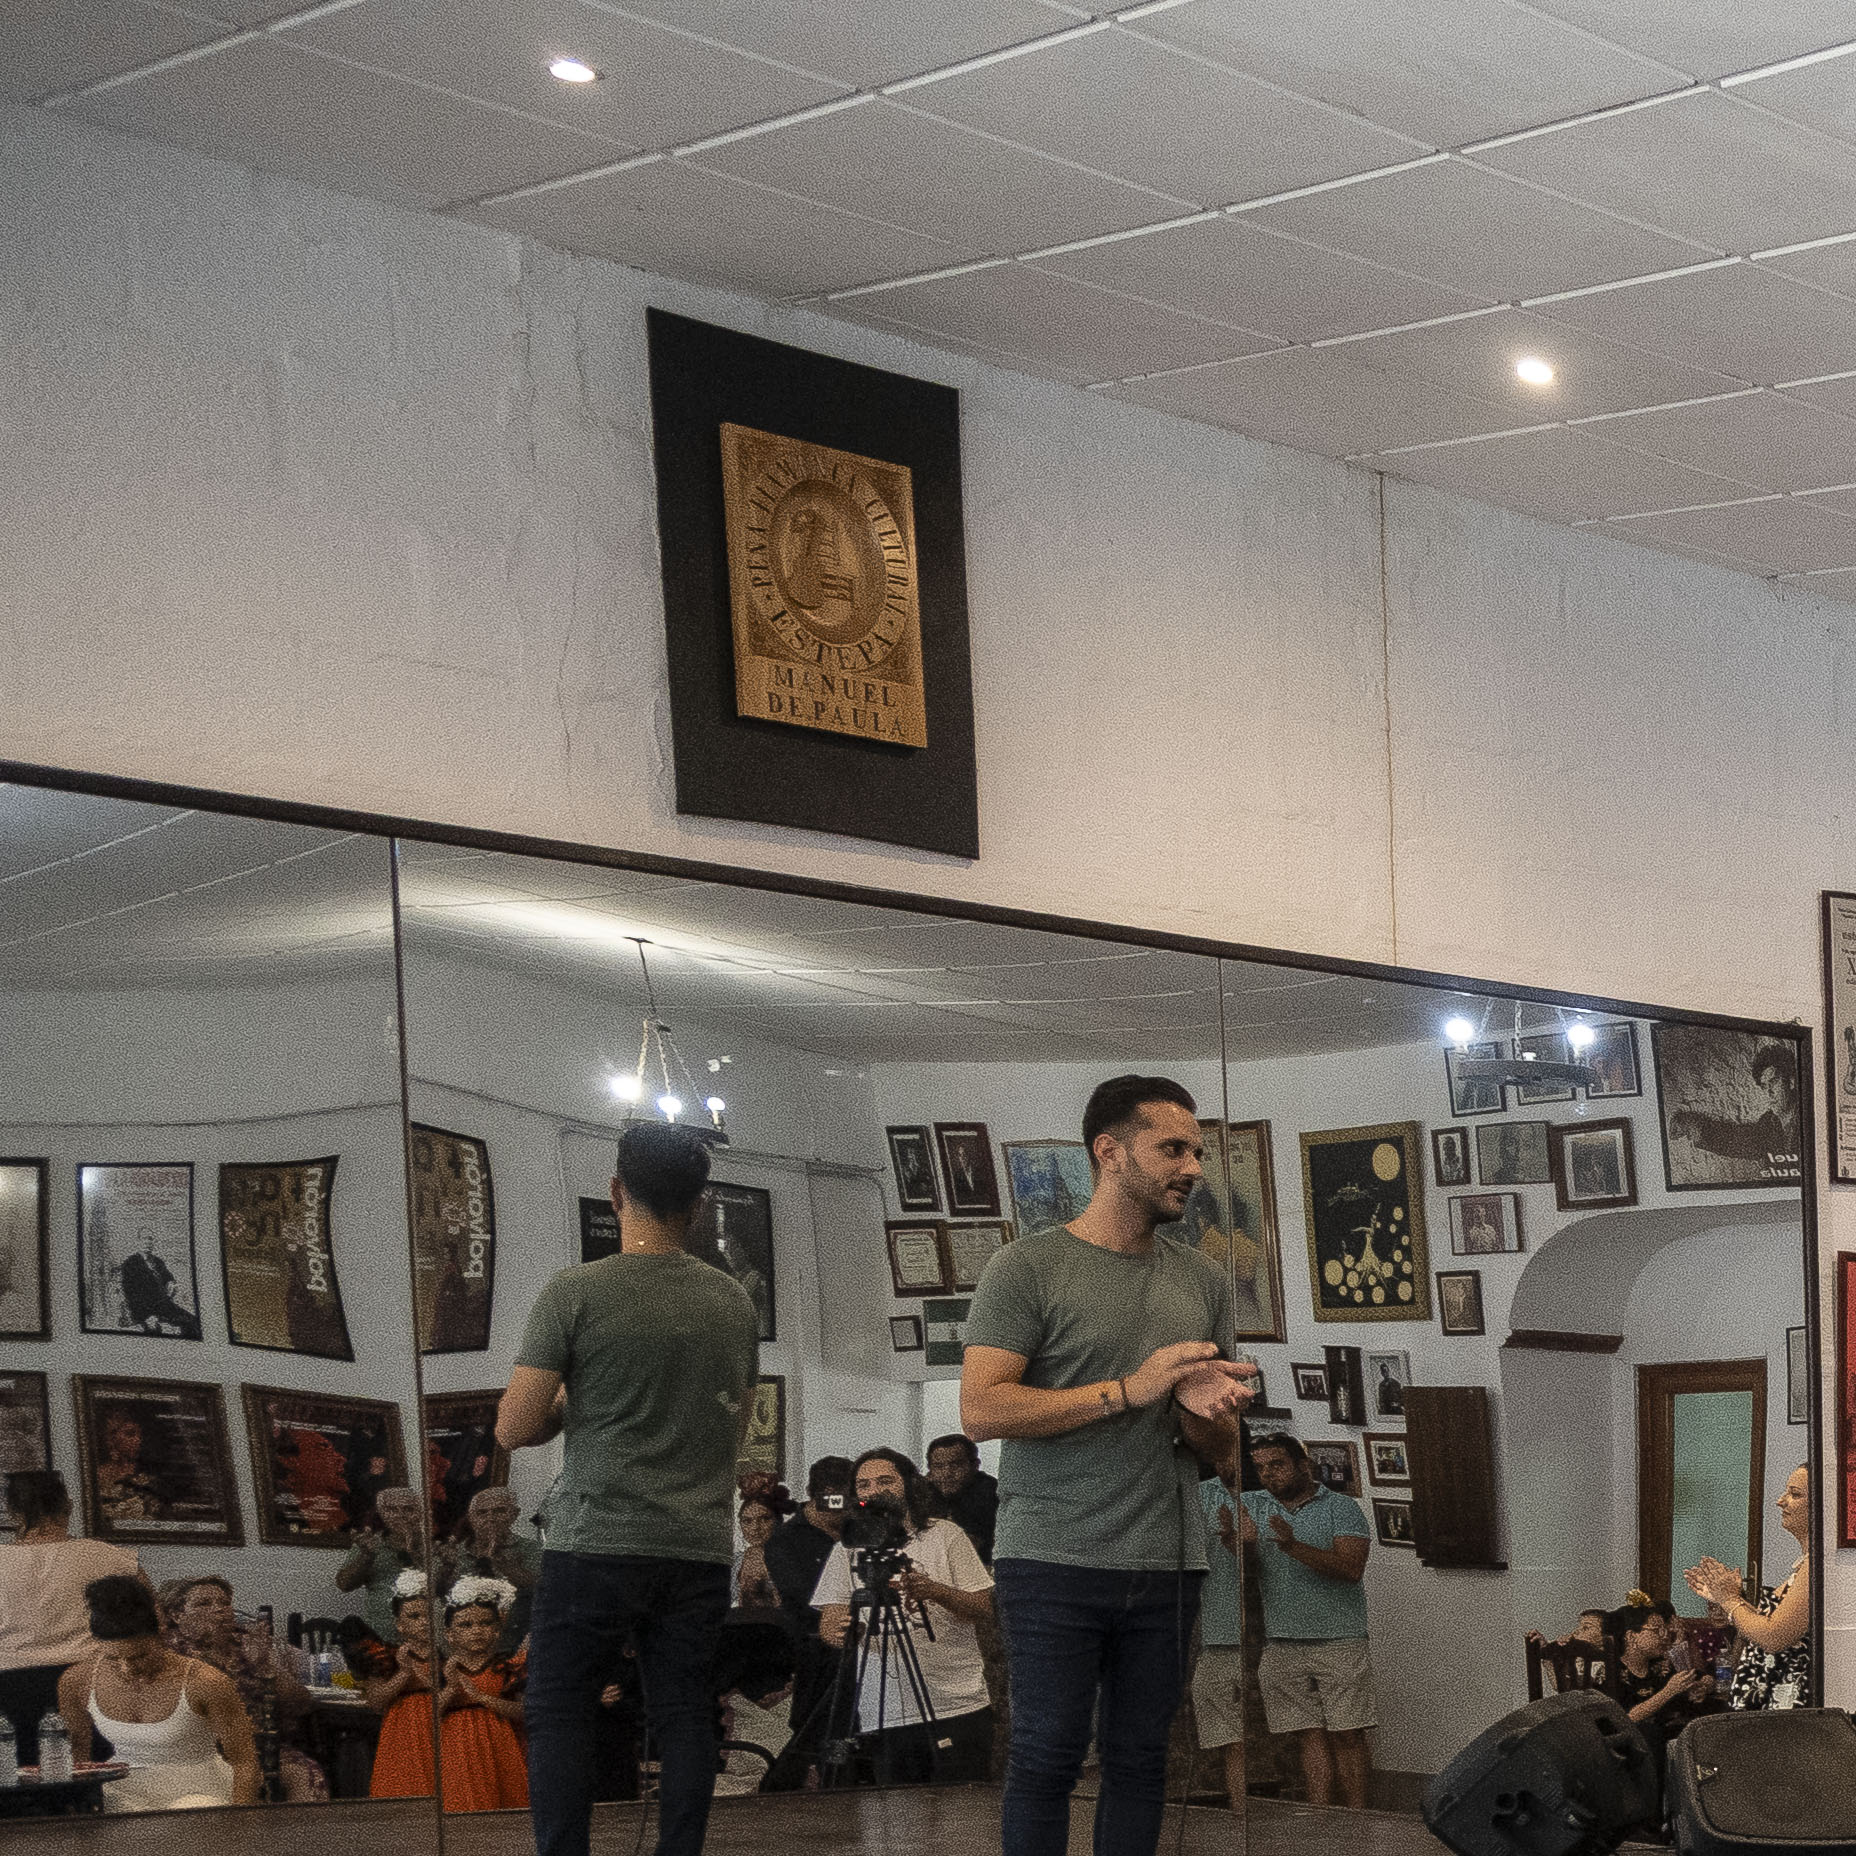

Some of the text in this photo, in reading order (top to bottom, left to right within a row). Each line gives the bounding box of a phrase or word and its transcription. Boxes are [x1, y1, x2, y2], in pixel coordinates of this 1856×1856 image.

[770, 608, 895, 670] ESTEPA
[774, 664, 896, 708] MANUEL
[767, 692, 903, 738] DE PAULA
